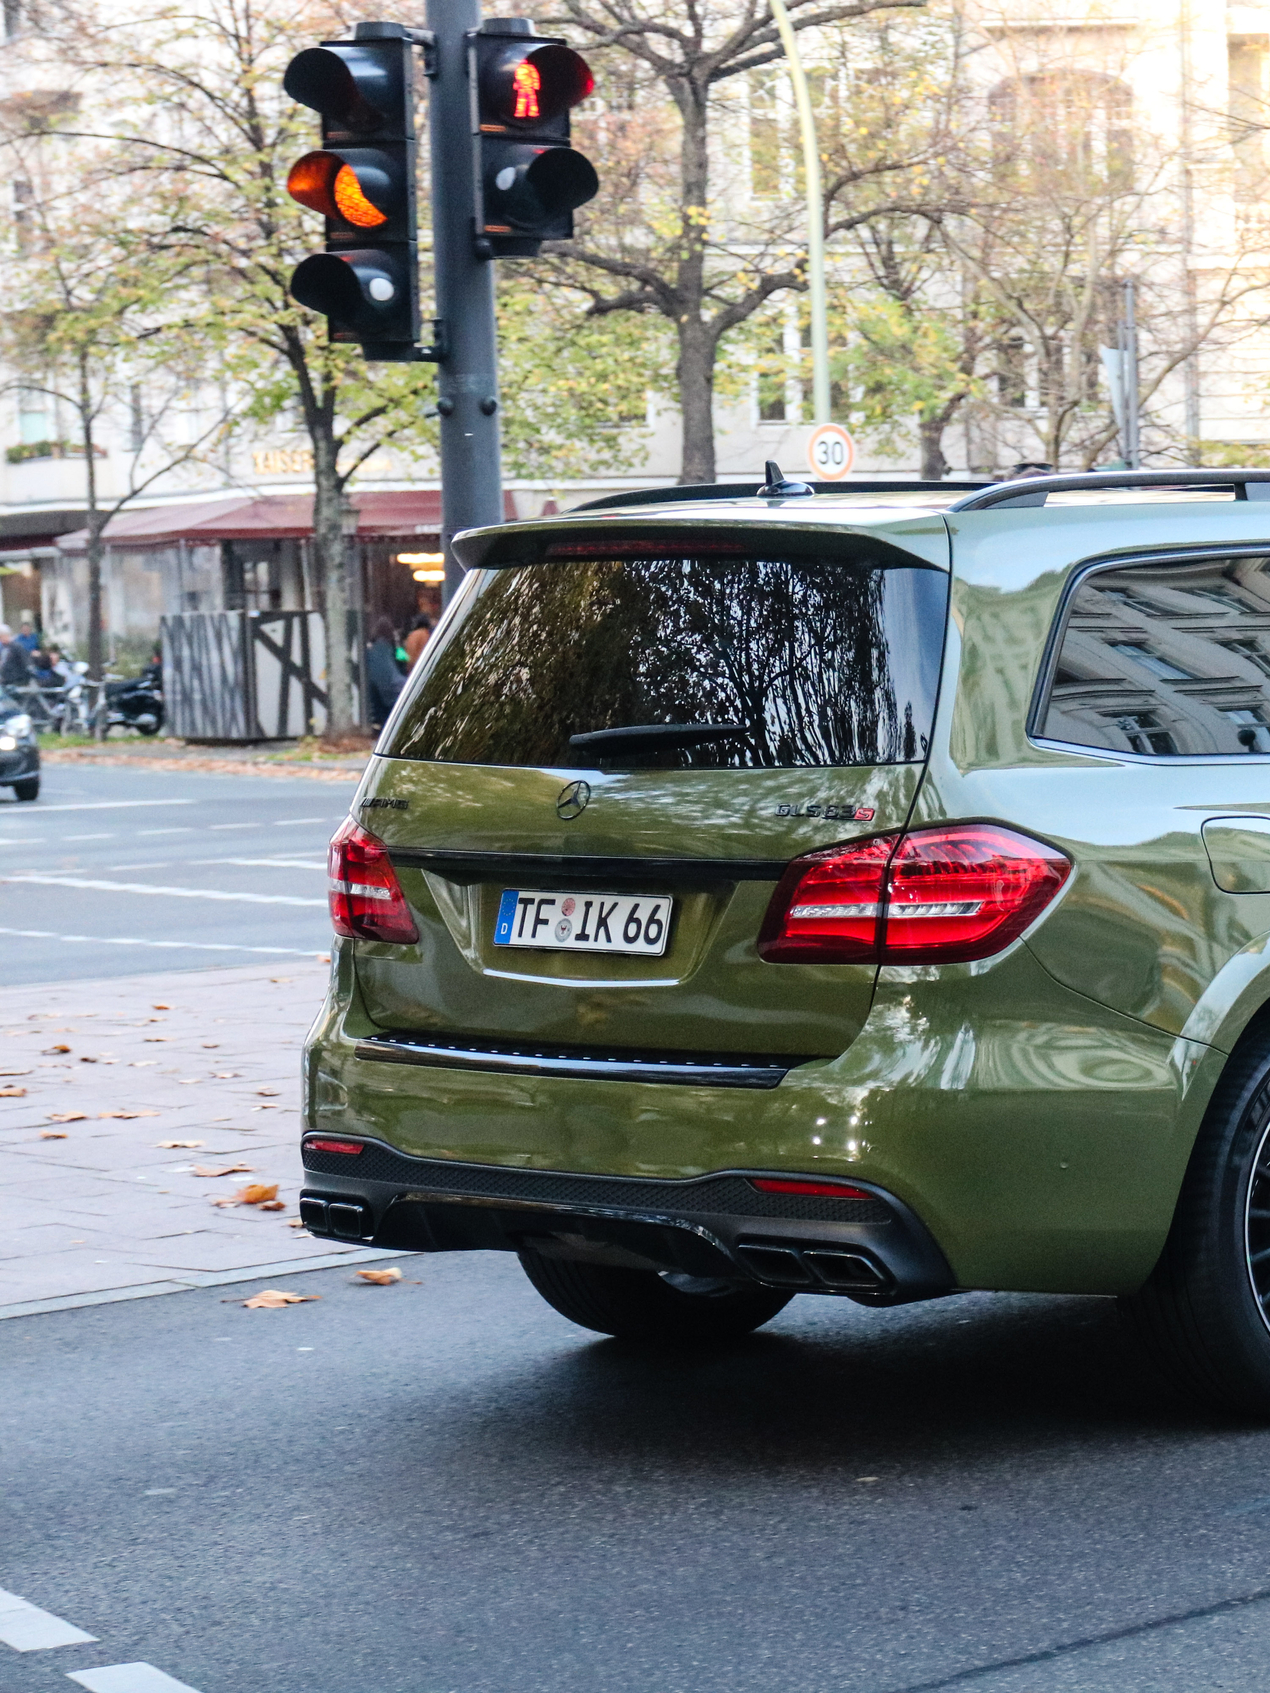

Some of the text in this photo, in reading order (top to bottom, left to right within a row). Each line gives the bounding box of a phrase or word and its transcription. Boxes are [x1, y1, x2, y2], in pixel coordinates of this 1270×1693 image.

[817, 440, 843, 465] 30
[501, 897, 664, 945] D TF IK 66
